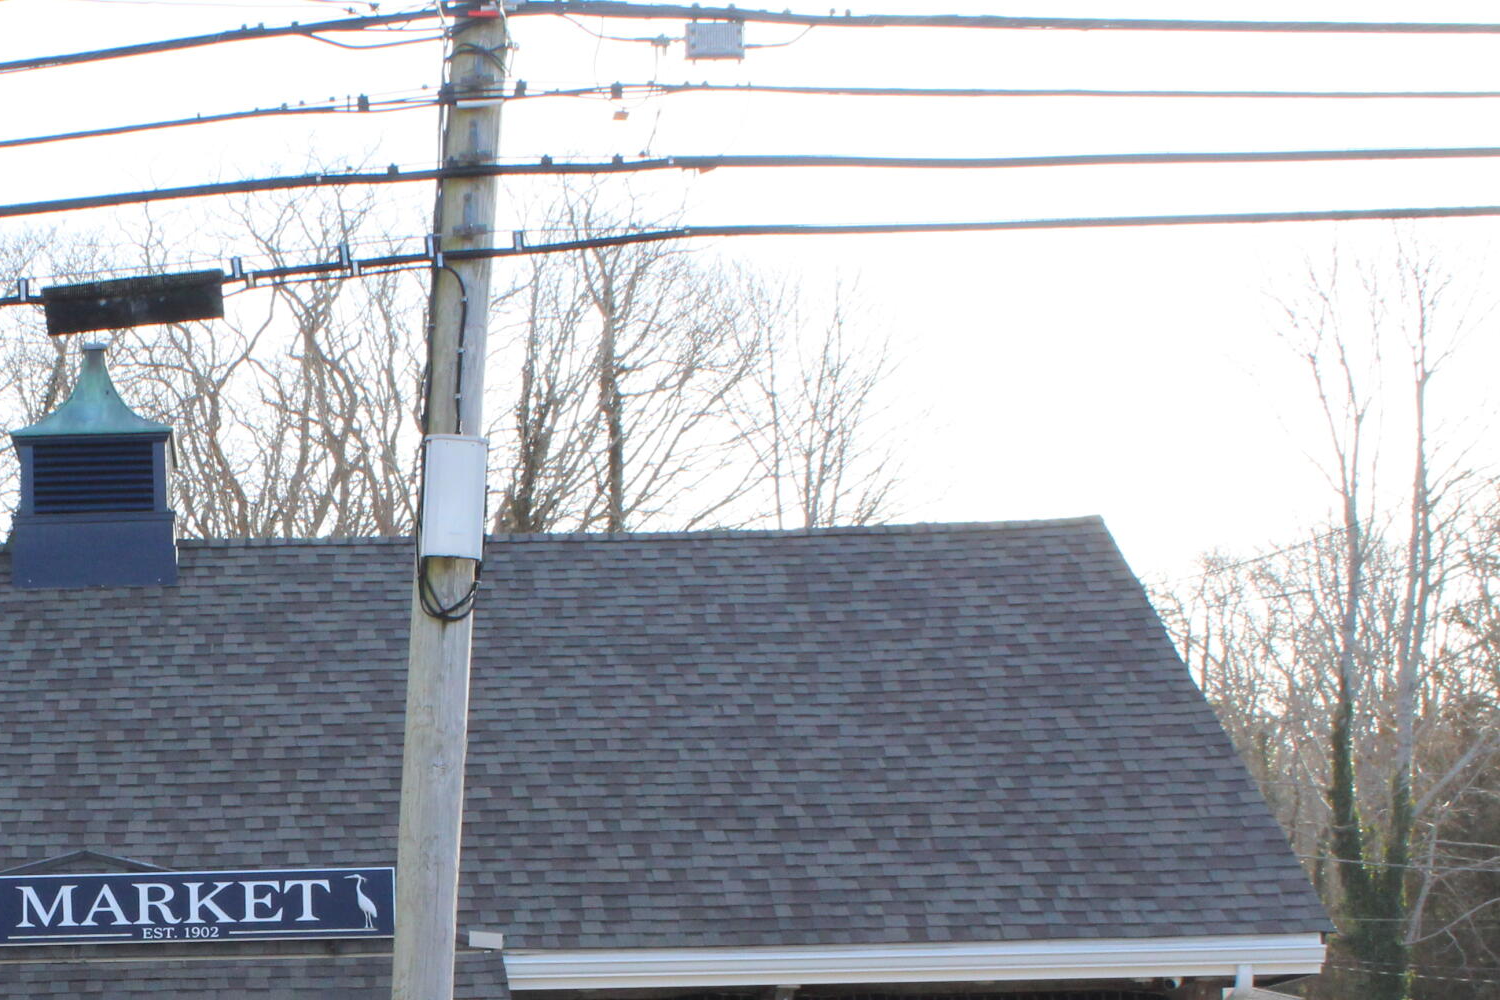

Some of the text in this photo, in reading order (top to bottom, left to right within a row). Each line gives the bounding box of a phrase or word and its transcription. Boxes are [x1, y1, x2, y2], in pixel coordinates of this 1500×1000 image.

[15, 879, 331, 928] MARKET
[142, 926, 219, 939] EST. 1902
